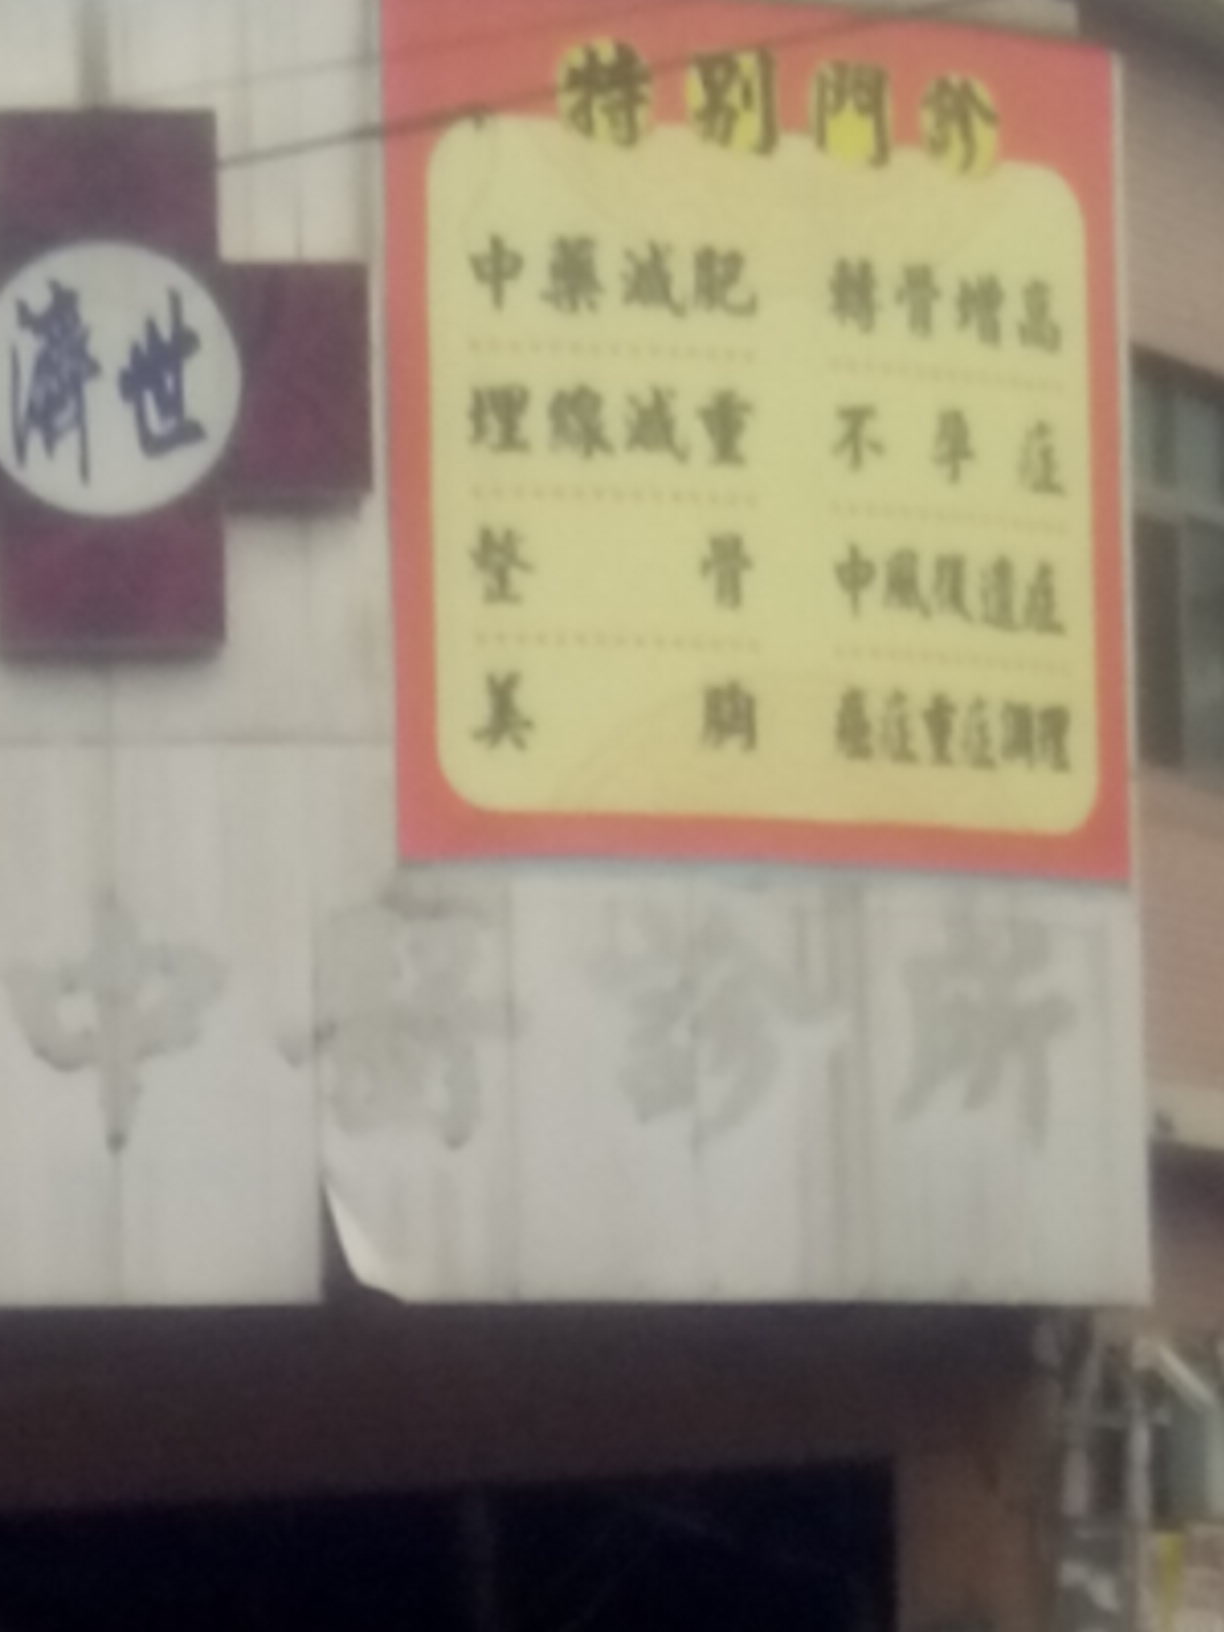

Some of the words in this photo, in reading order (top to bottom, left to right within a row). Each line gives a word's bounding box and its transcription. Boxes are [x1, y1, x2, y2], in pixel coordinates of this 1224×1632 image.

[561, 40, 1000, 171] 特別門診
[469, 234, 758, 317] 中藥減肥
[829, 258, 1063, 352] 轉骨增高
[9, 277, 208, 488] 濟世
[831, 404, 1066, 496] 不孕症
[471, 526, 754, 610] 整骨
[834, 543, 1067, 635] 中風後遺症
[472, 670, 758, 752] 美胸
